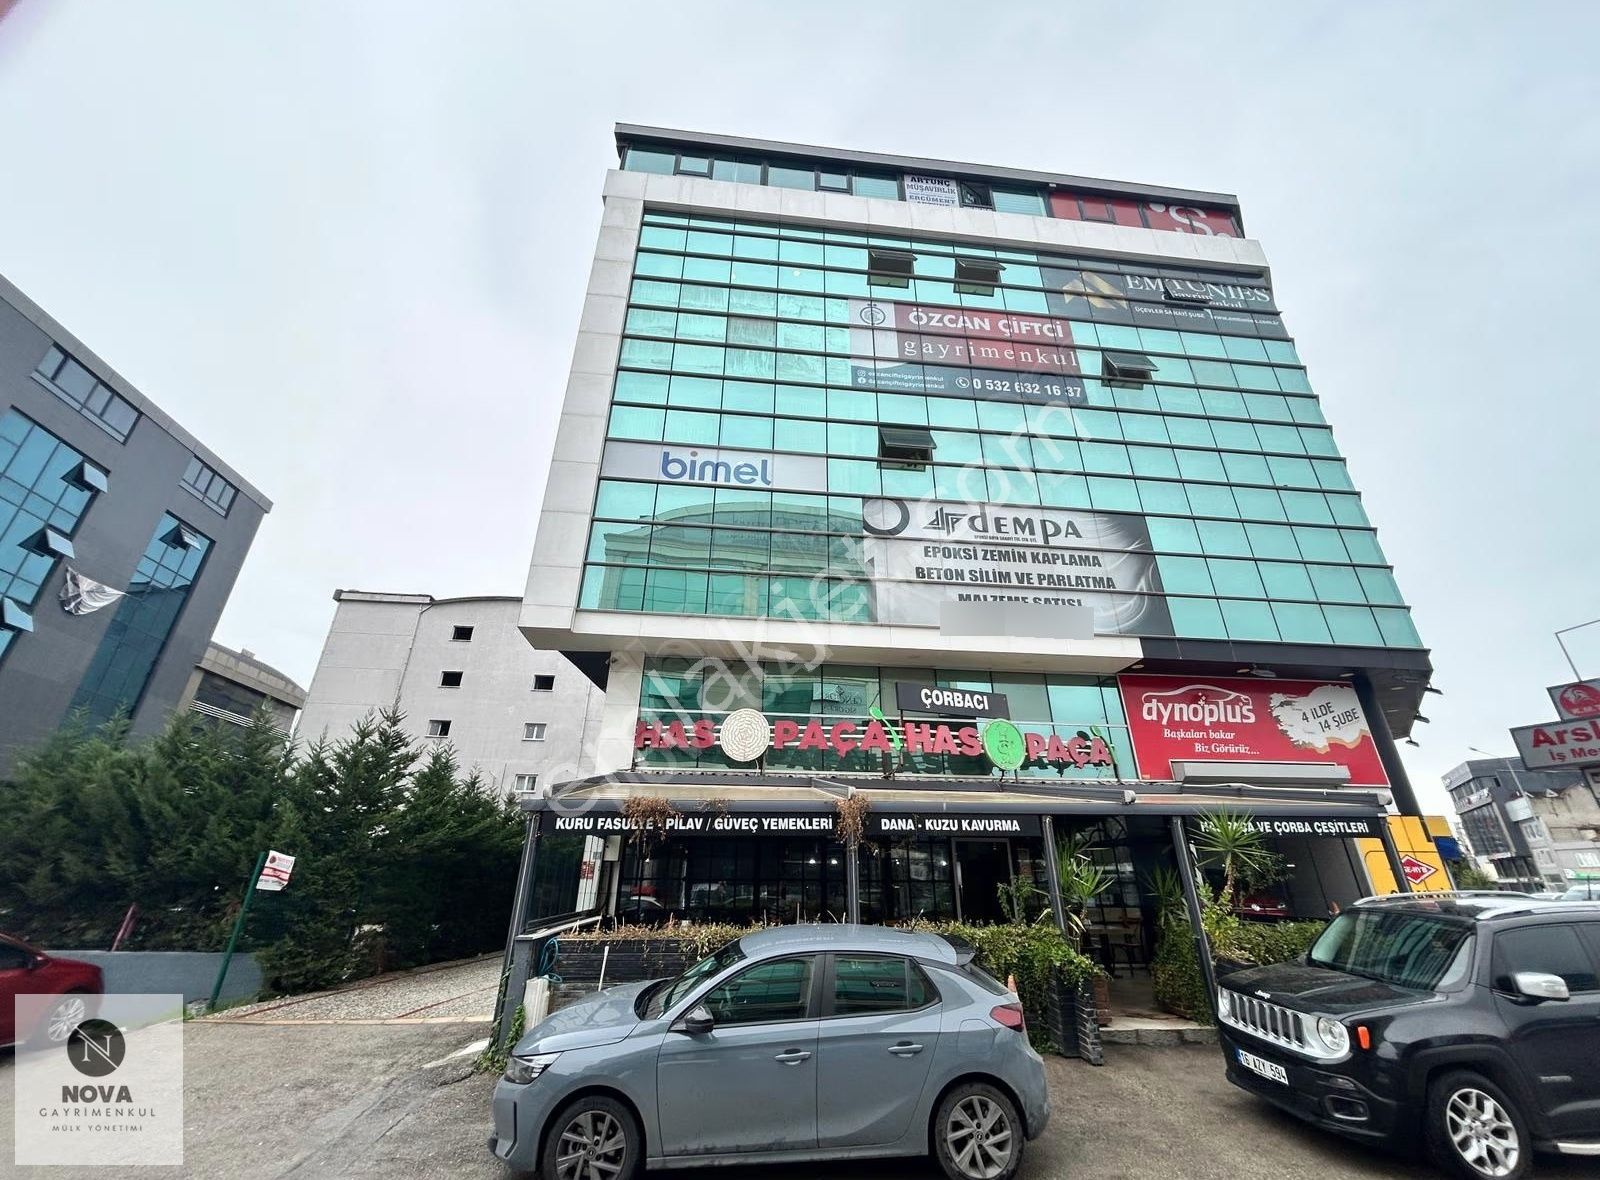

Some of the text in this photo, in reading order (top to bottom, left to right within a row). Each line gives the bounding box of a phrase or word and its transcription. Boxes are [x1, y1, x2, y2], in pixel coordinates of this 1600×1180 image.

[908, 308, 991, 330] ÖZCAN
[904, 339, 1079, 367] gayrimenkul
[973, 379, 1082, 398] 0 532 632 16 37
[661, 451, 772, 486] bimel
[924, 546, 1102, 568] EPOKSİ ZEMİN KAPLAMA
[915, 566, 1116, 590] BETON SİLİM VE PARLATMA
[920, 687, 989, 710] ÇORBACI
[1142, 698, 1256, 726] dynoplus
[1302, 712, 1310, 723] 4
[1164, 728, 1236, 740] Başkaları bakar
[1319, 720, 1331, 732] 14
[634, 720, 1113, 769] HAS PAÇA HAS PAÇA
[1194, 743, 1210, 754] Biz
[1570, 748, 1600, 759] Me
[555, 817, 595, 830] KURU
[665, 814, 703, 830] PİLAV
[714, 815, 760, 834] GÜVEÇ
[762, 814, 833, 830] YEMEKLERİ
[881, 818, 915, 831] DANA
[925, 818, 959, 831] KUZU
[962, 819, 1020, 832] KAVURMA
[1256, 821, 1273, 833] VE
[1274, 821, 1313, 836] ÇORBA
[1314, 820, 1369, 836] ÇEŞİTLERİ
[1270, 1064, 1287, 1082] 594
